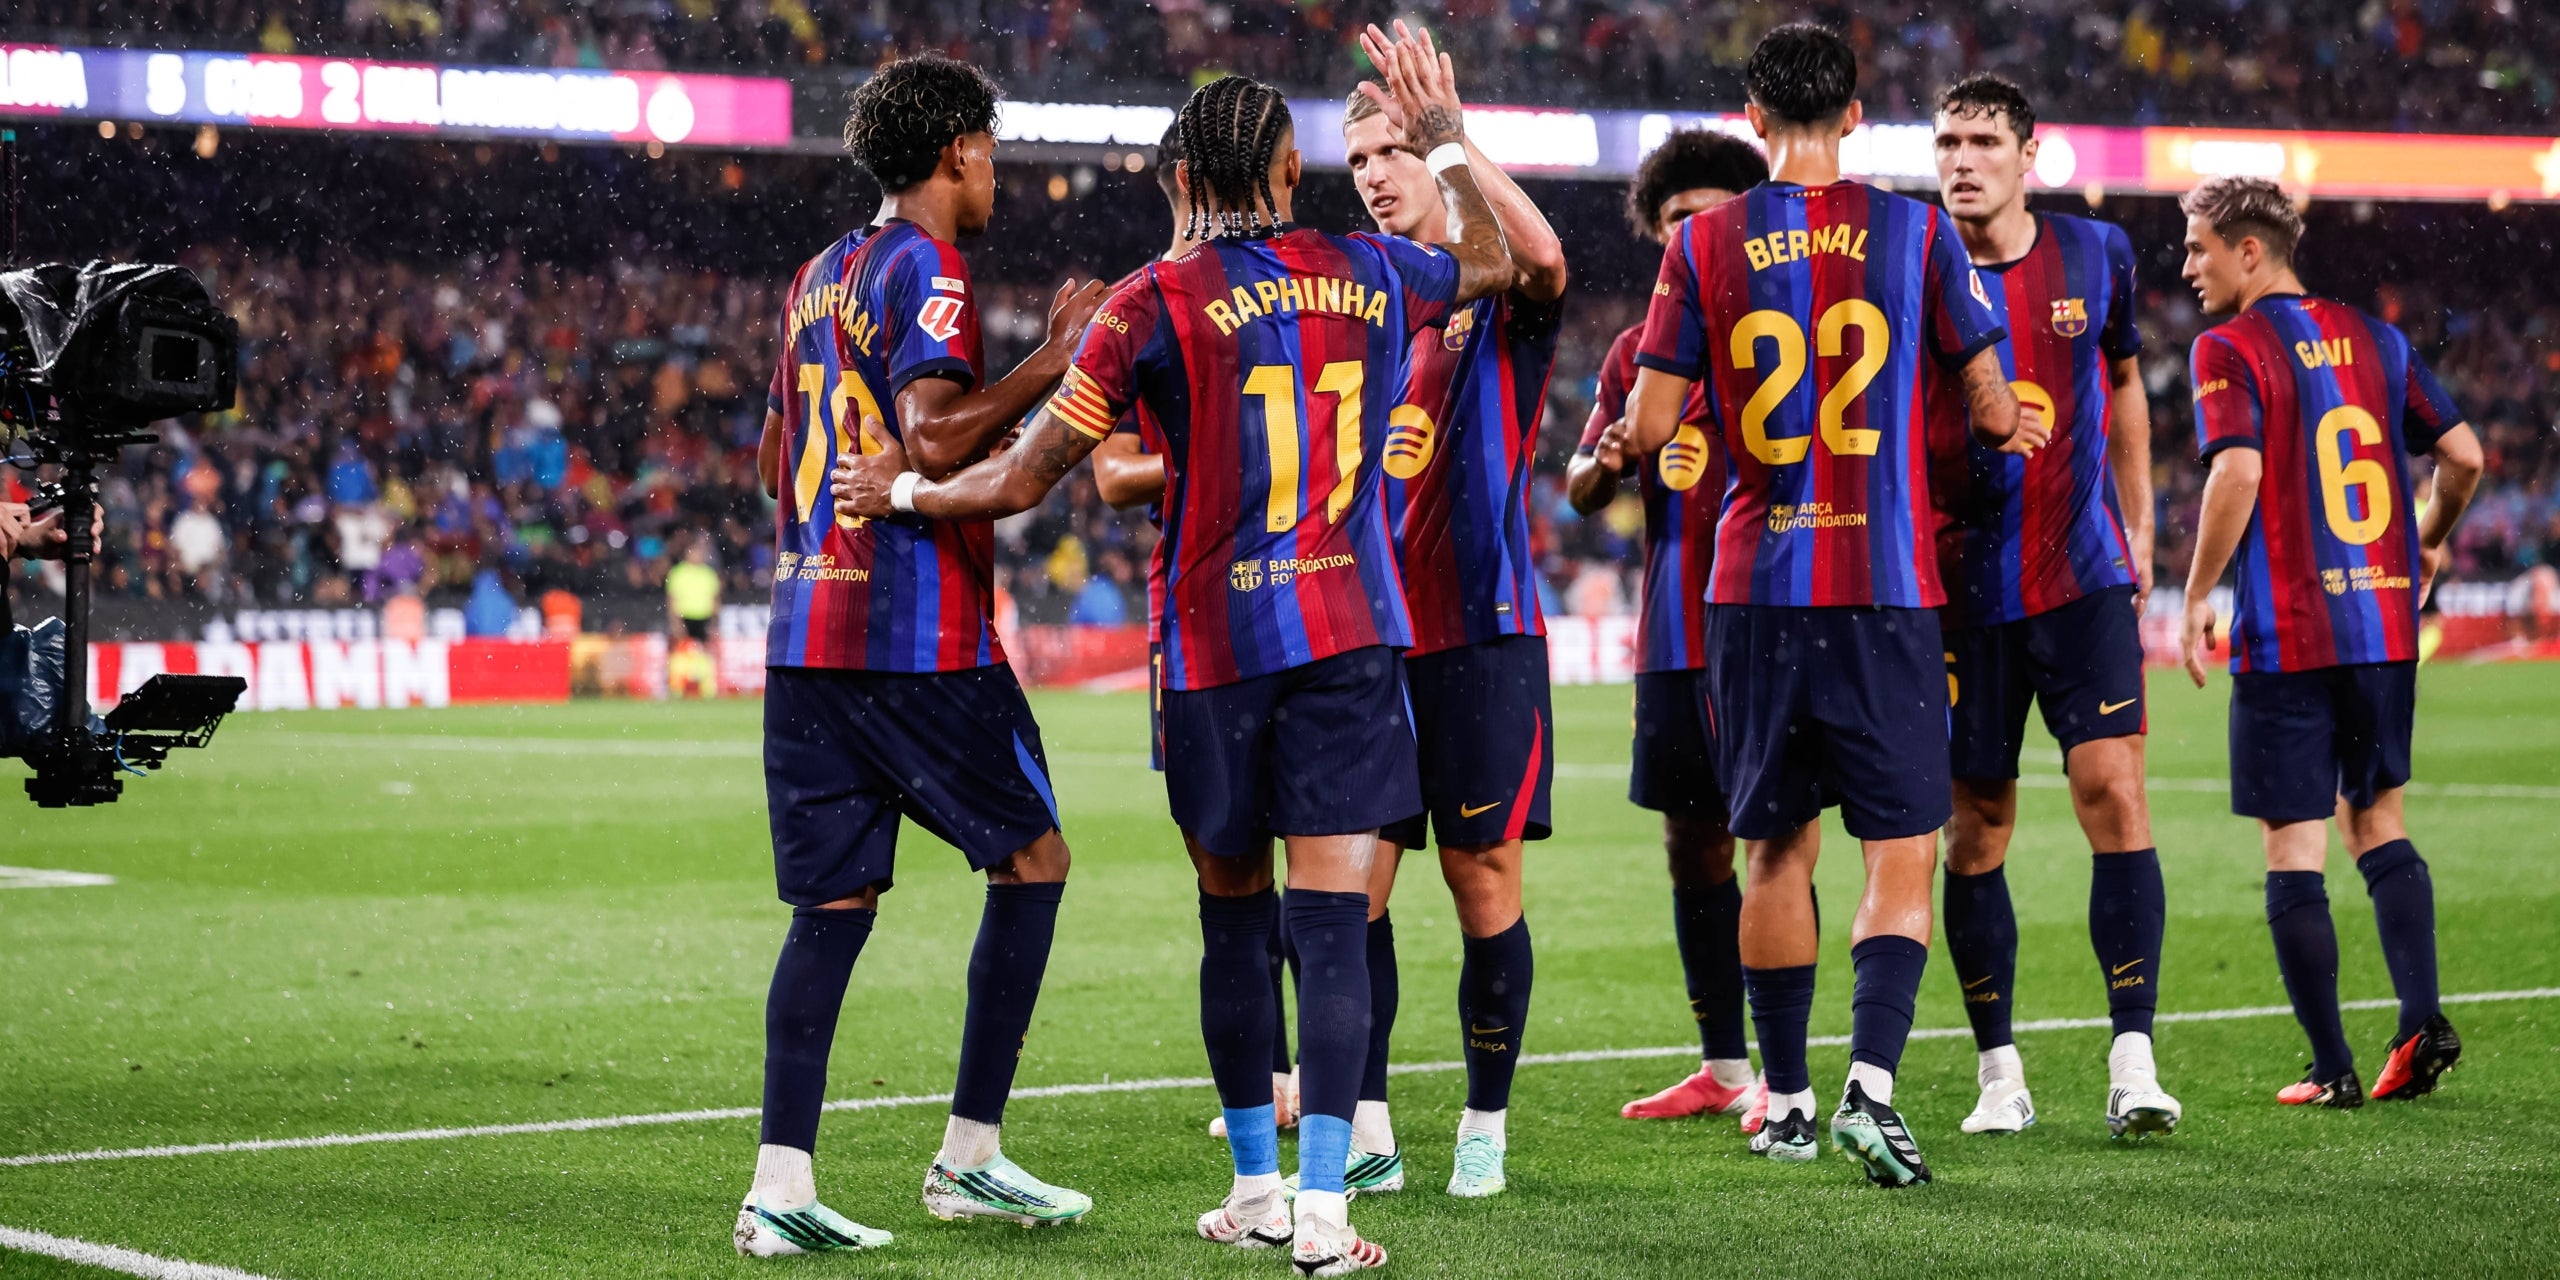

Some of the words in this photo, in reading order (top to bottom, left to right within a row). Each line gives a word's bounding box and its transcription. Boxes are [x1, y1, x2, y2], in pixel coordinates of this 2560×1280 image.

[321, 61, 361, 123] 2
[1743, 222, 1869, 272] BERNAL
[1204, 276, 1388, 337] RAPHINHA
[1730, 299, 1890, 465] 22
[2295, 337, 2353, 369] GAVI
[1242, 360, 1364, 533] 11
[2315, 405, 2392, 545] 6
[1797, 502, 1833, 517] ARÇA
[797, 568, 869, 582] FOUNDATION
[196, 641, 450, 711] DAMM
